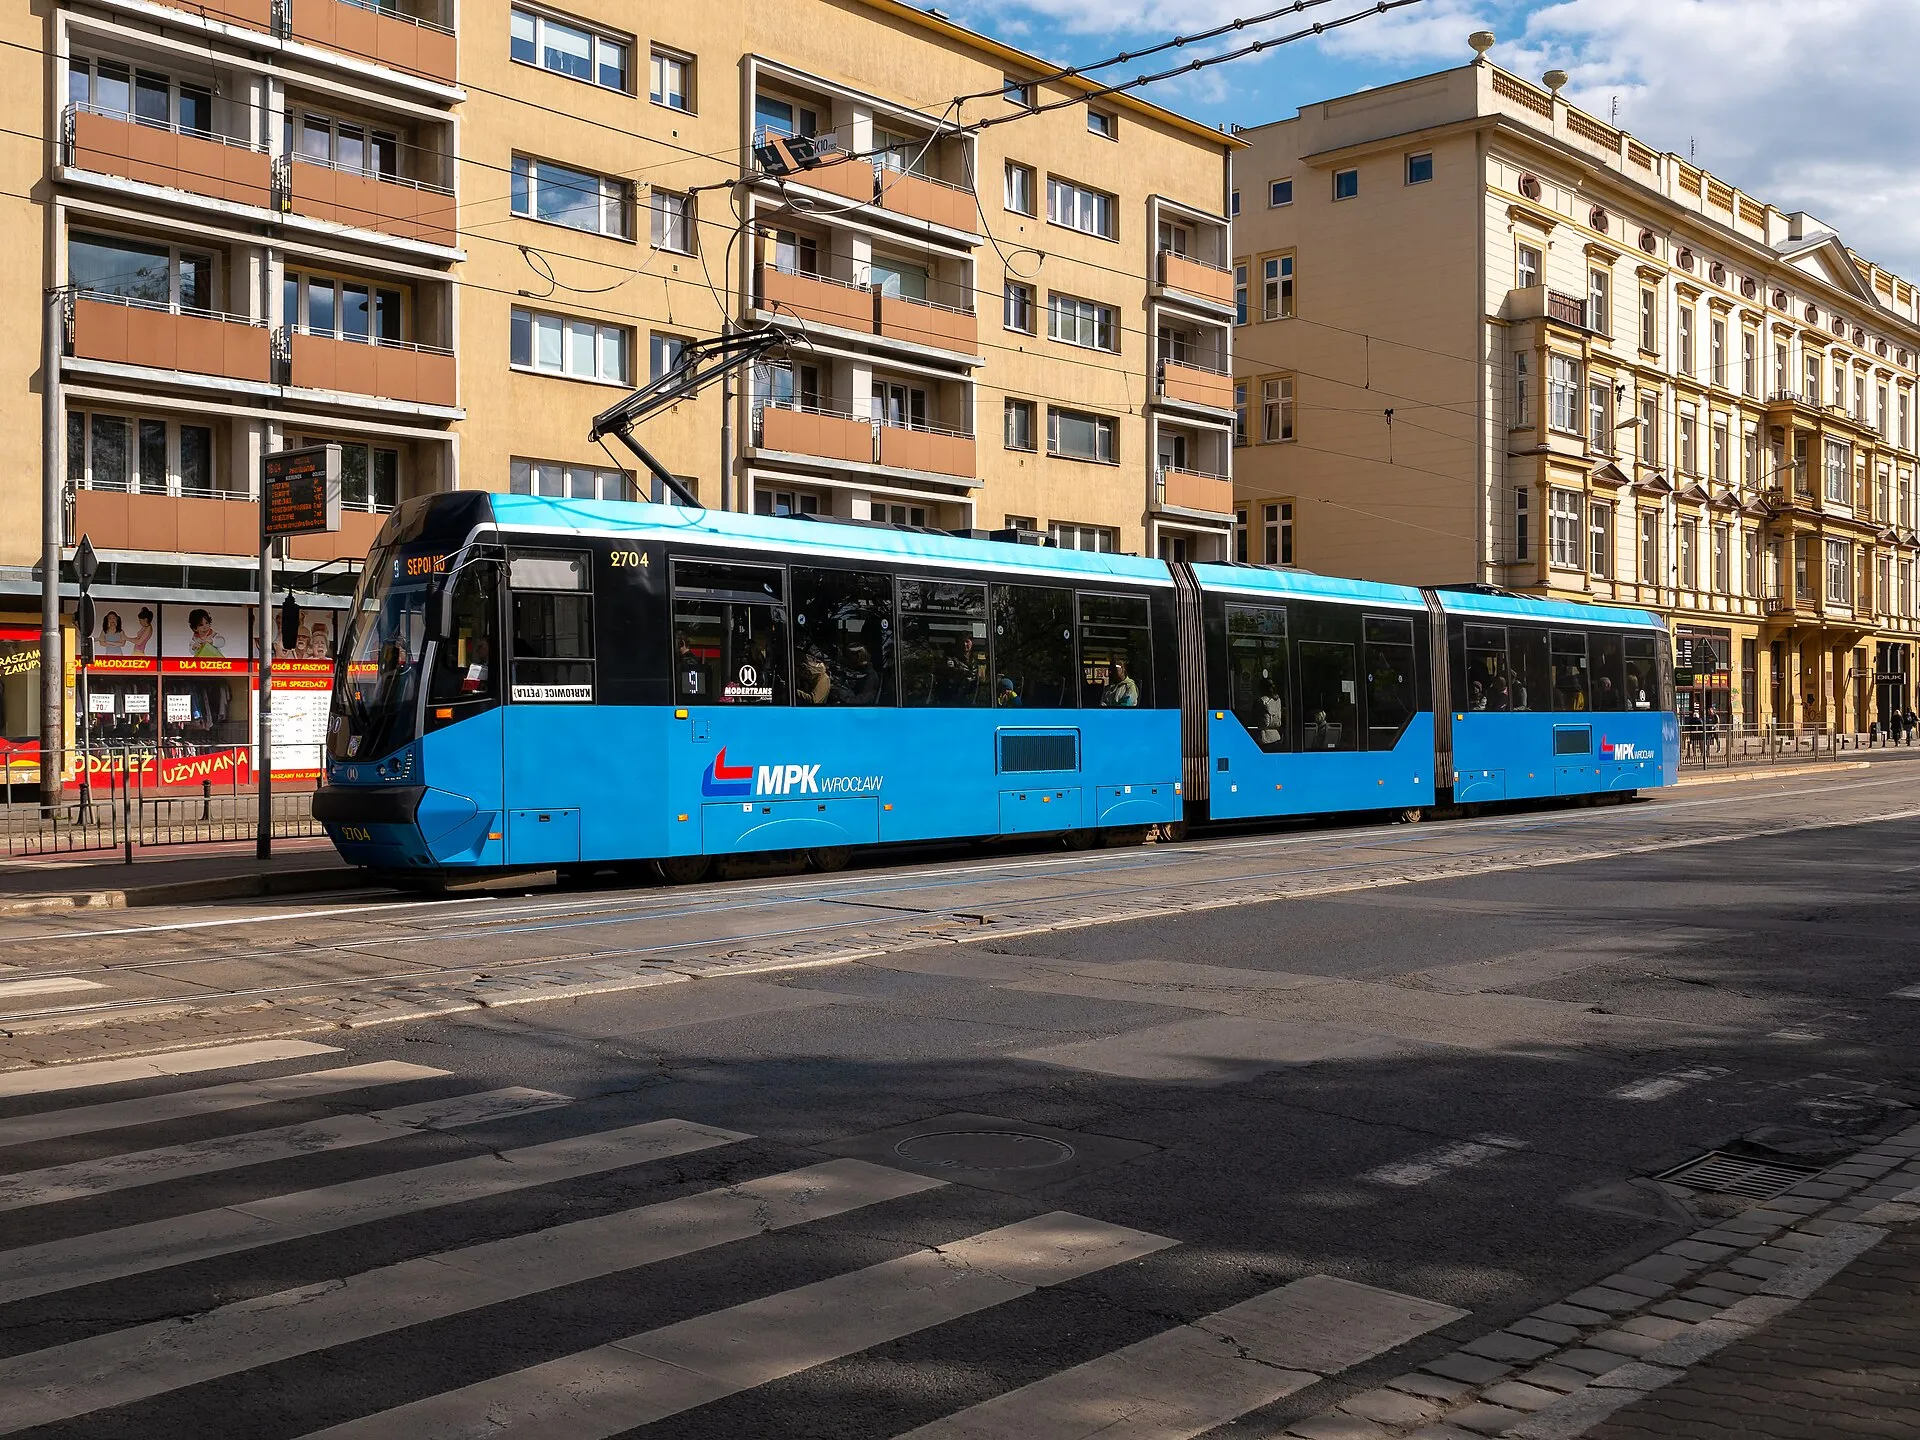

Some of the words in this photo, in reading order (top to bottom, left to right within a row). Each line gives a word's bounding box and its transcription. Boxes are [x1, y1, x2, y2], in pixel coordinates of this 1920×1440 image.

[814, 139, 827, 153] K10
[610, 551, 649, 567] 2704
[394, 560, 399, 577] 9
[0, 649, 41, 667] RASZAM
[94, 659, 151, 668] MŁODZIEŻY
[180, 661, 197, 669] DLA
[200, 661, 232, 669] DZIECI
[272, 662, 291, 671] OSÓB
[289, 680, 328, 688] SPRZEDAŻY
[514, 687, 544, 699] (PĘTLA)
[545, 688, 591, 698] KARŁOWICE
[724, 687, 772, 695] MODERTRANS
[1614, 743, 1635, 761] MPK
[163, 751, 248, 783] UŻYWANA
[756, 764, 821, 795] MPK
[821, 776, 884, 793] WROCŁAW
[342, 827, 371, 840] 2704
